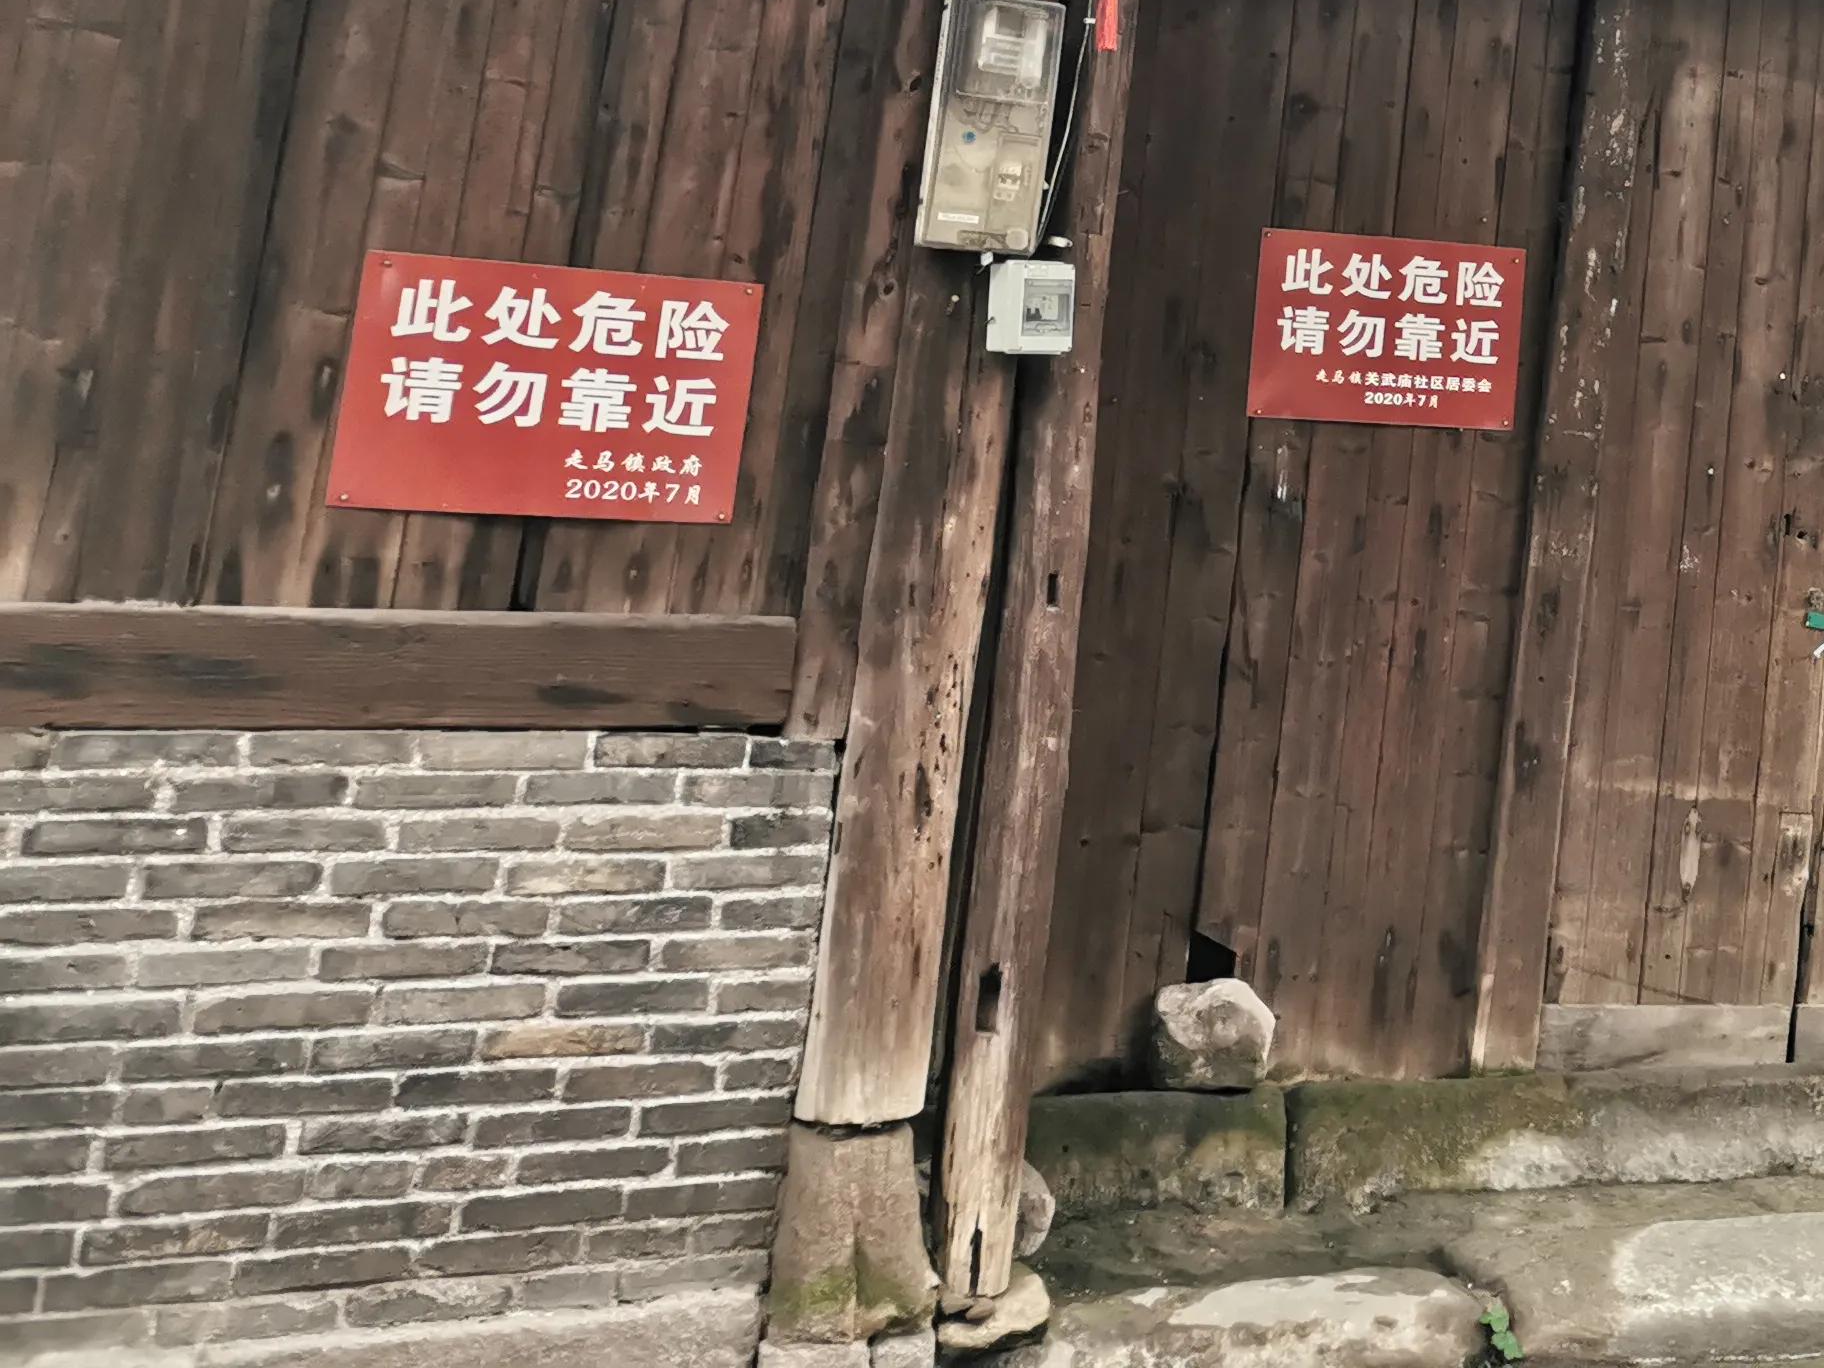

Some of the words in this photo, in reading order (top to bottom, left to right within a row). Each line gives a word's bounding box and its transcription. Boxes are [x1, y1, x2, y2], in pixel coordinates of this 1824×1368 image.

[1281, 248, 1504, 308] 此处危险
[390, 278, 730, 361] 此处危险
[1277, 306, 1500, 365] 请勿靠近
[380, 356, 717, 437] 请勿靠近
[1315, 368, 1493, 393] 走马镇关武庙社区居委会
[1364, 391, 1439, 409] 2020年7月
[563, 448, 702, 477] 走马镇政府
[564, 478, 701, 506] 2020年7月
